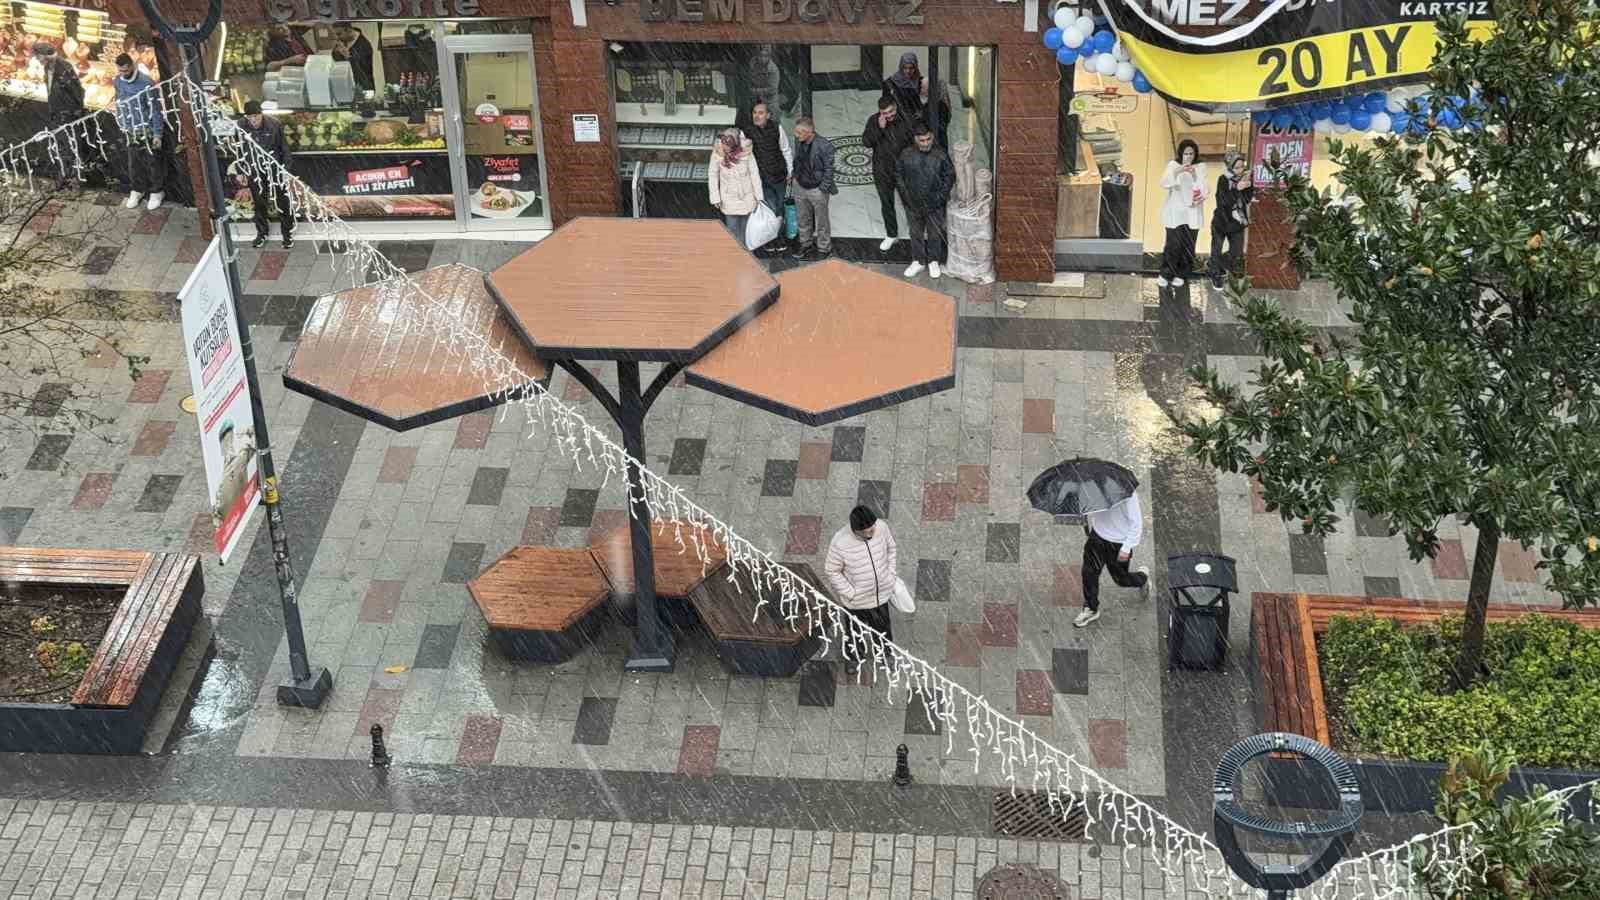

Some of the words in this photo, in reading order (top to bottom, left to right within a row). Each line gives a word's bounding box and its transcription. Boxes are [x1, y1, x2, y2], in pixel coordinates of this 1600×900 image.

[1400, 1, 1489, 16] KARTSIZ
[1257, 40, 1322, 97] 20
[1346, 25, 1412, 82] AY
[1264, 141, 1304, 161] EDEN
[343, 183, 370, 194] TATLI
